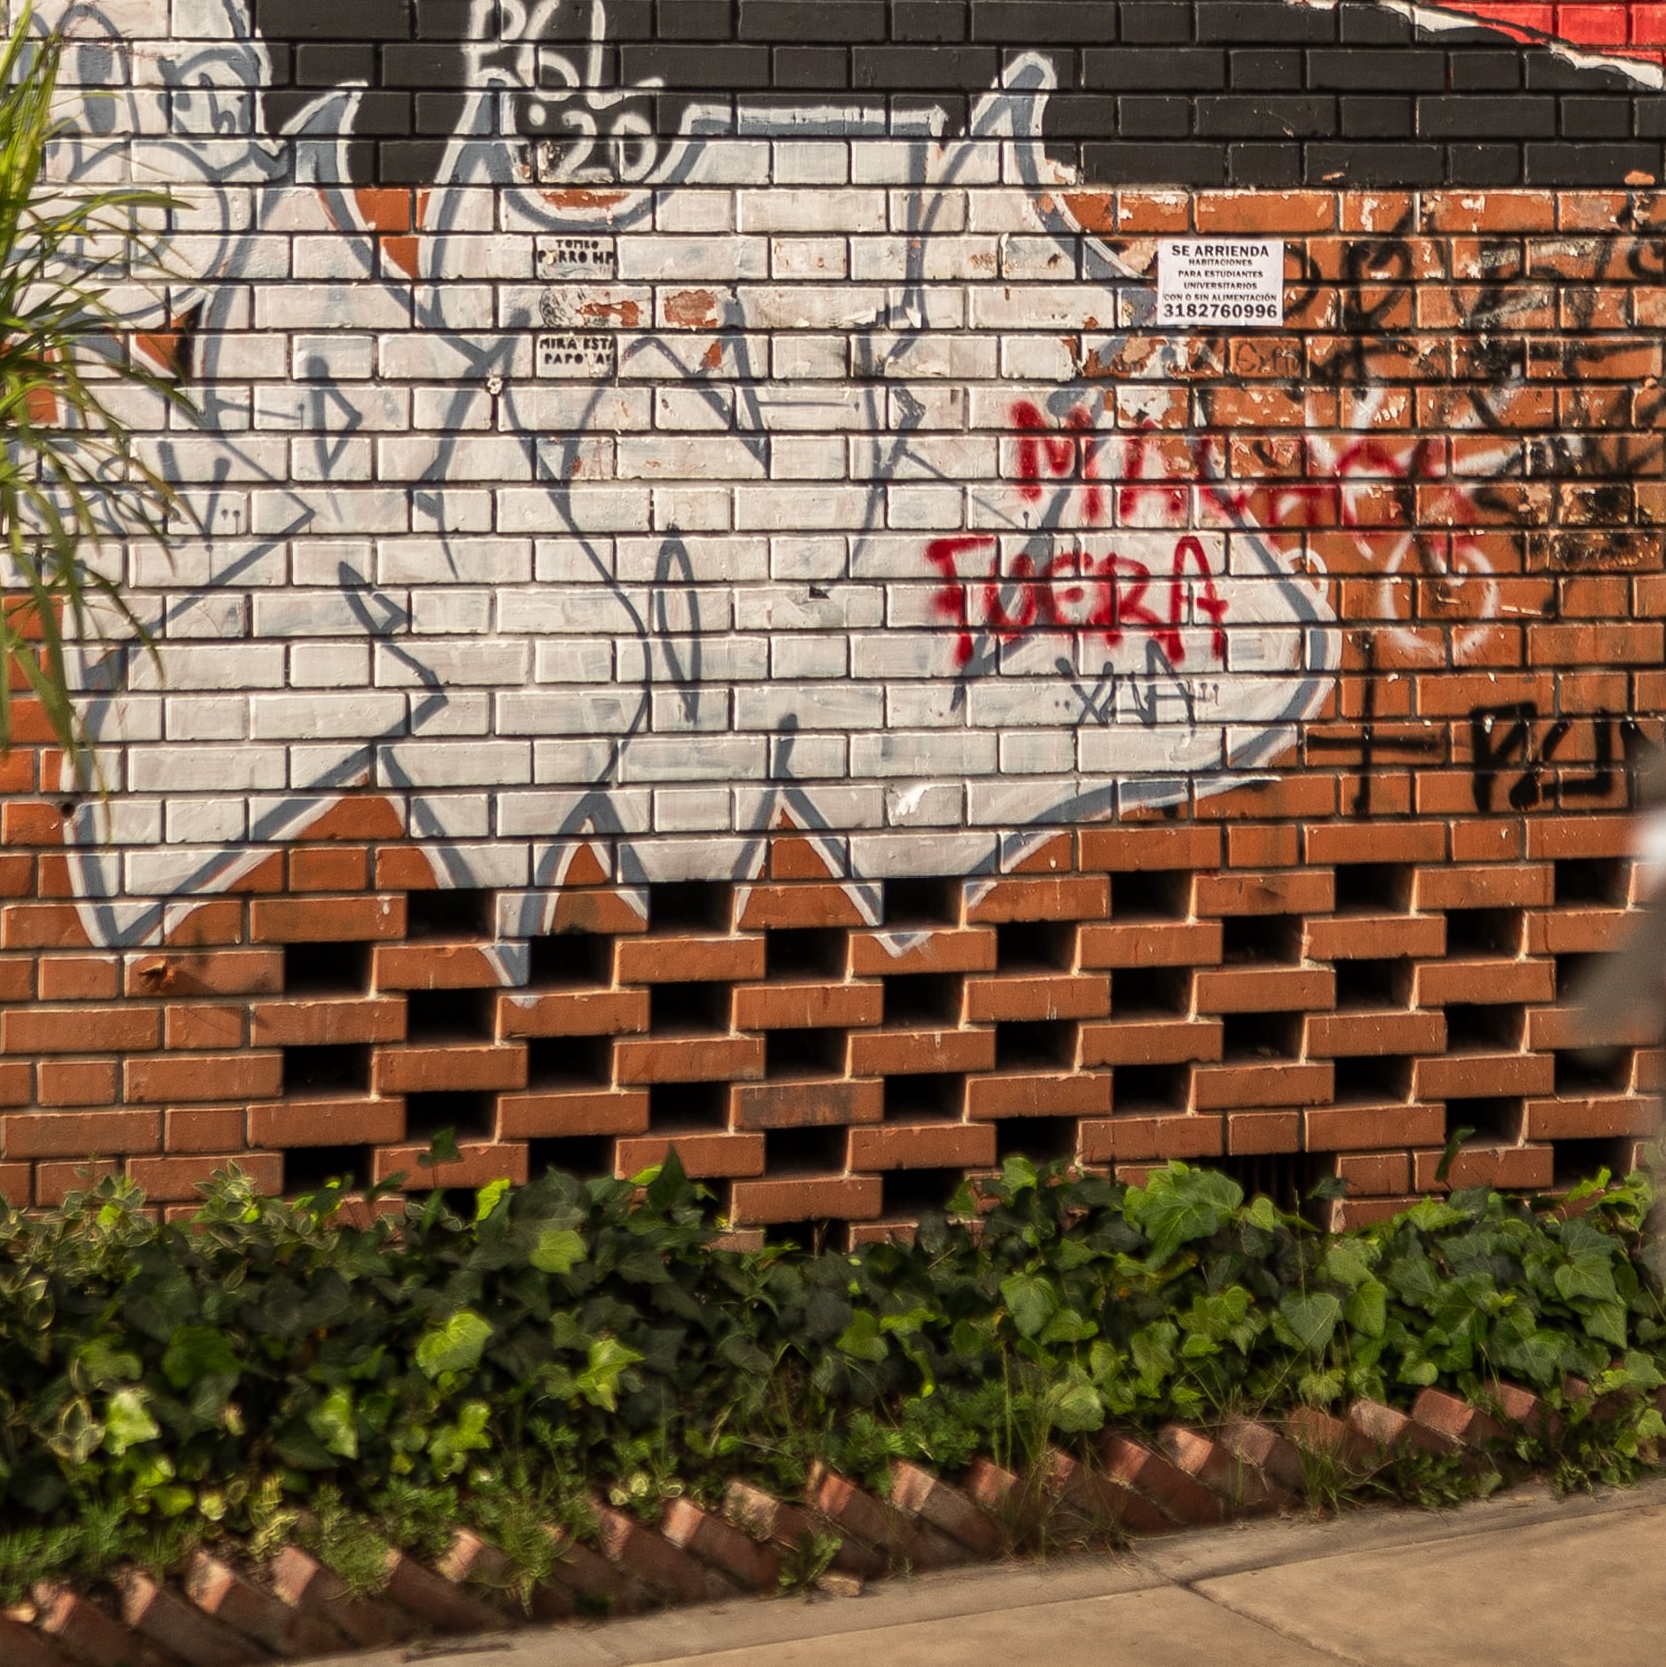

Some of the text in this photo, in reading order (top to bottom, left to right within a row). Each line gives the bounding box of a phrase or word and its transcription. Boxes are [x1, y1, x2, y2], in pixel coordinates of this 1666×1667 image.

[1171, 245, 1269, 257] SE ARRIENDA
[537, 250, 588, 265] PRRO
[1178, 270, 1264, 278] PARA ESTUDIANTES
[1183, 282, 1258, 290] UNIVERSITARIOS
[1164, 294, 1183, 302] CON
[1212, 293, 1277, 302] ALIMENTACIÓN
[1163, 304, 1278, 319] 3182760996
[539, 338, 578, 350] MIRA
[924, 533, 1228, 666] FUERA
